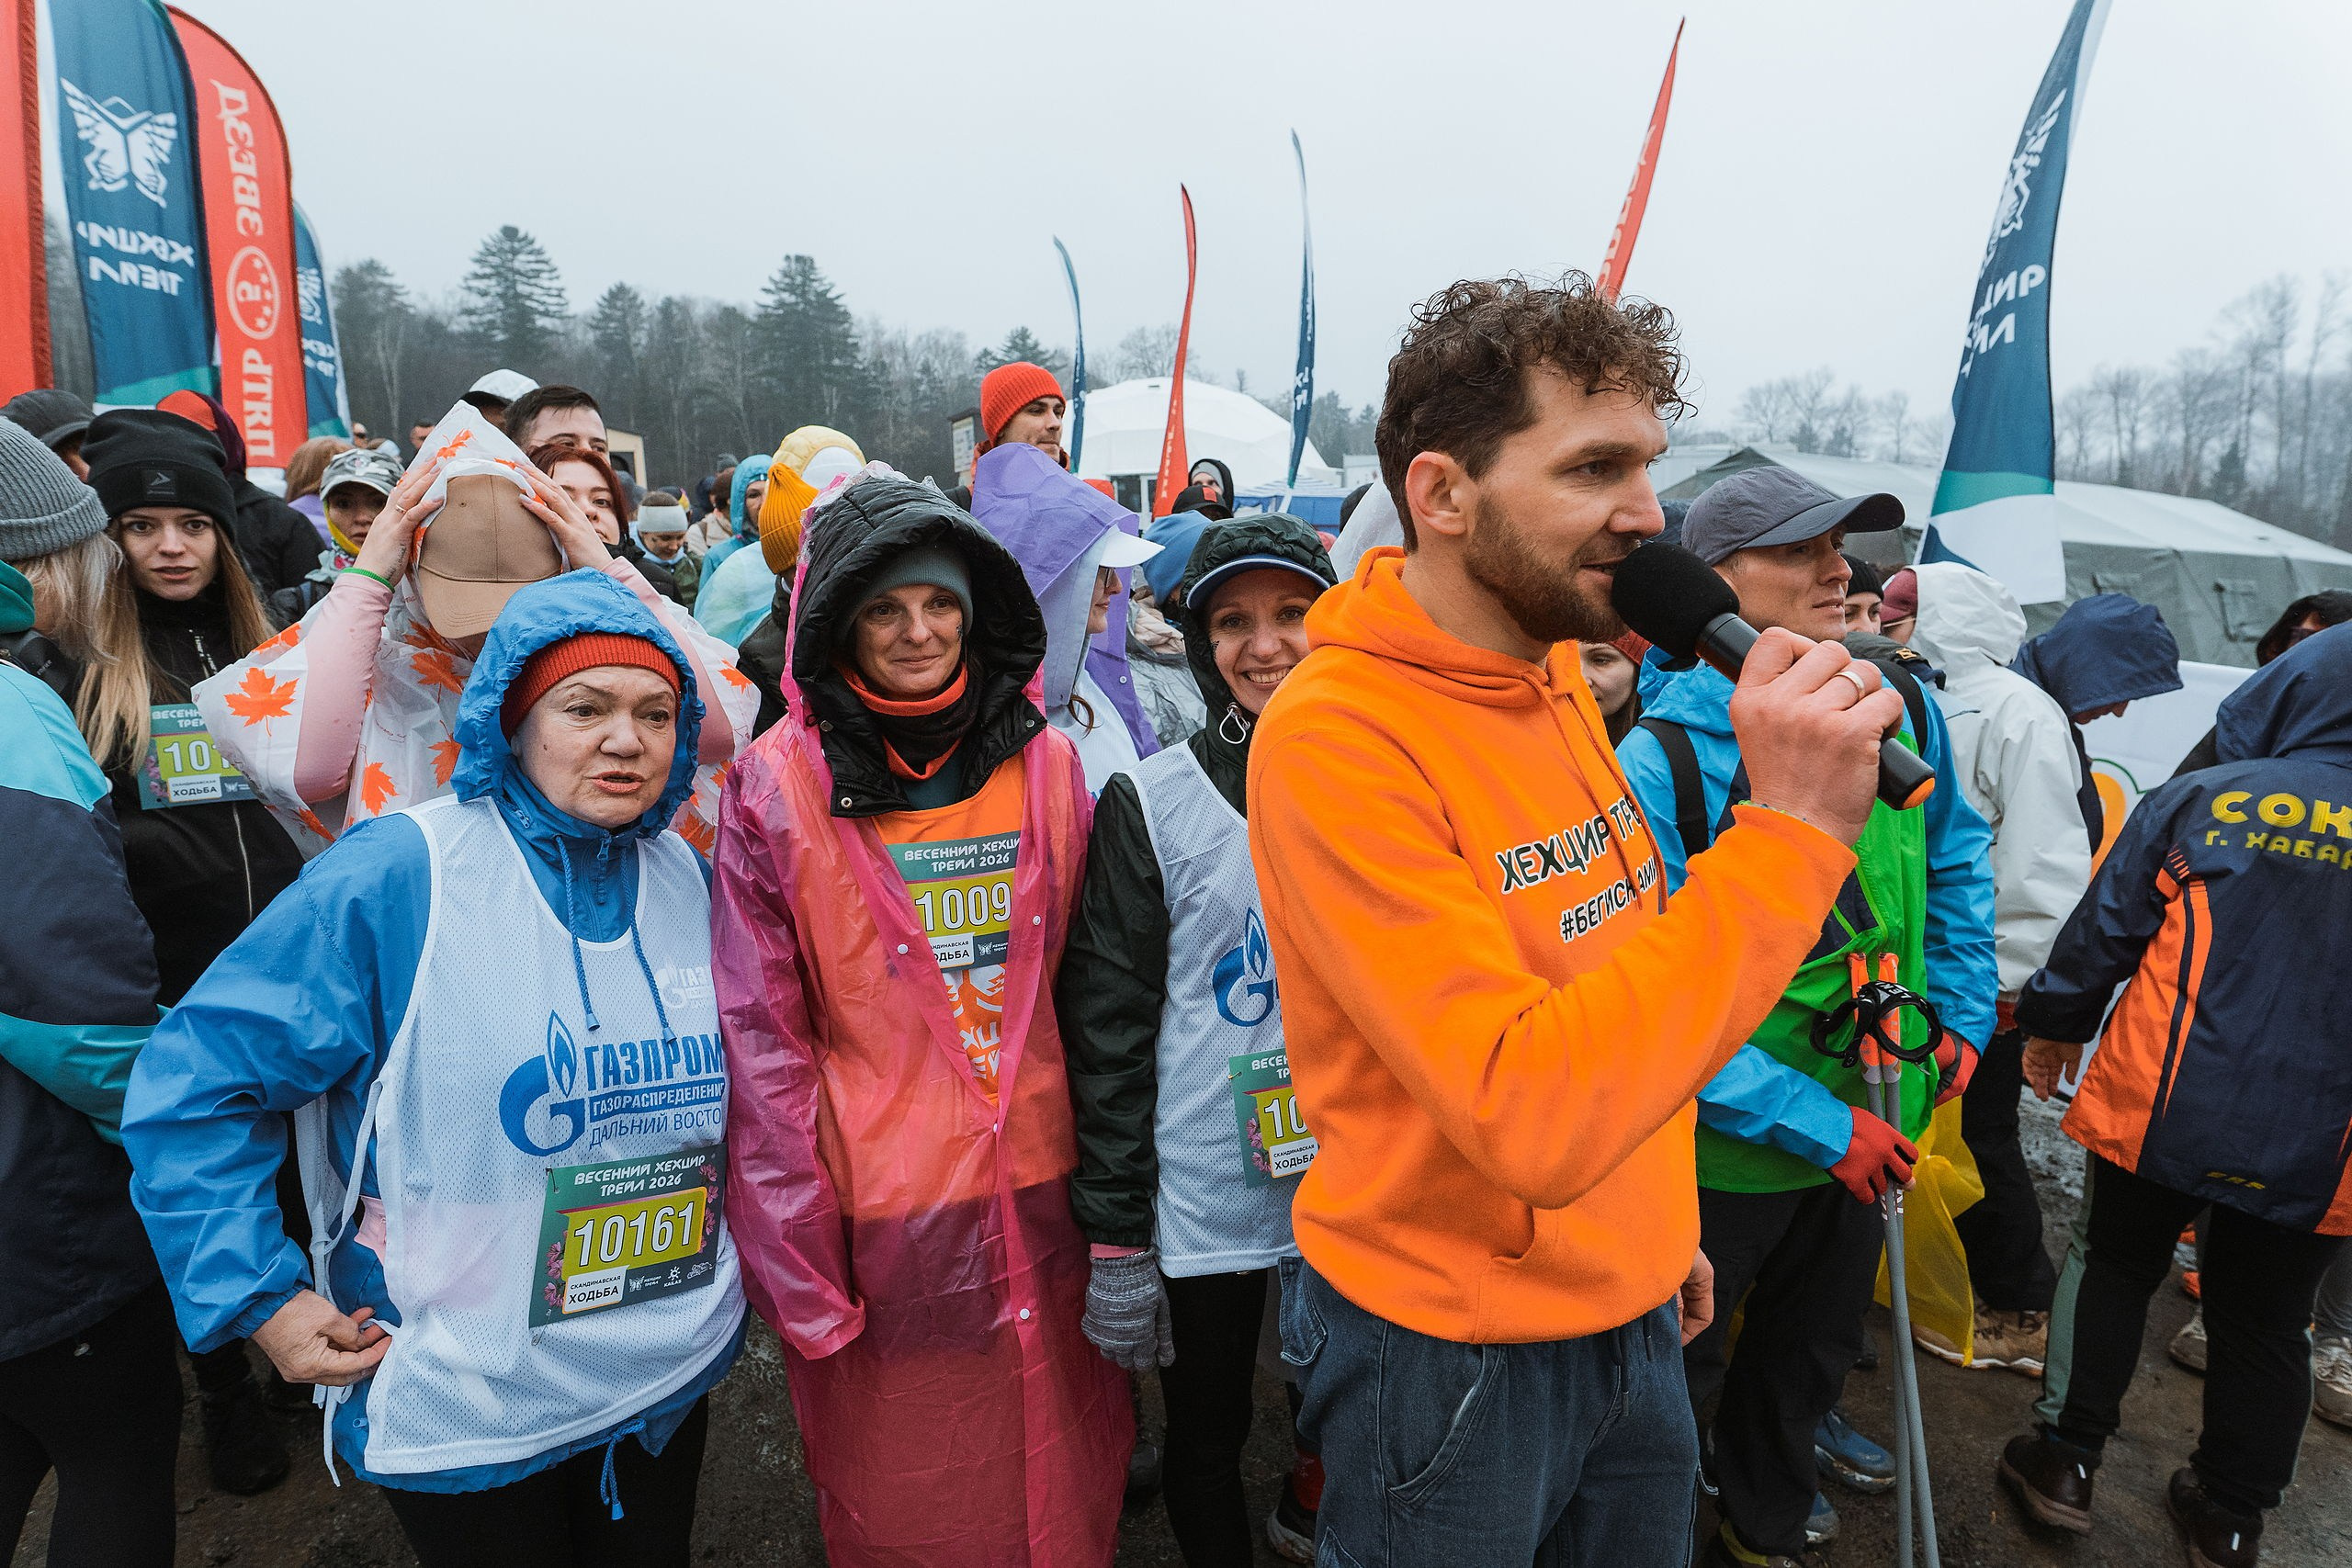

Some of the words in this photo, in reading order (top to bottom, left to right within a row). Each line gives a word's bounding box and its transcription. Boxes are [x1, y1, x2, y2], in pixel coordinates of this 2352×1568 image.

[173, 786, 217, 796] ХОДЬБА
[904, 844, 978, 862] ВЕСЕННИЙ
[931, 858, 975, 872] ТРЕЙЛ
[979, 852, 1010, 867] 2026
[1496, 814, 1611, 893] ХЕХЦИР
[584, 1032, 723, 1091] ГАЗПРОМ
[589, 1113, 668, 1150] ДАЛЬНИЙ
[1273, 1144, 1315, 1158] СКАНДИНАВСКАЯ
[574, 1165, 651, 1185] ВЕСЕННИЙ
[654, 1155, 706, 1173] ХЕХЦИР
[1274, 1153, 1315, 1170] ХОДЬБА
[600, 1179, 644, 1197] ТРЕЙЛ
[649, 1172, 684, 1190] 2026
[573, 1201, 695, 1268] 10161
[570, 1275, 621, 1290] СКАНДИНАВСКАЯ
[568, 1285, 619, 1305] ХОДЬБА
